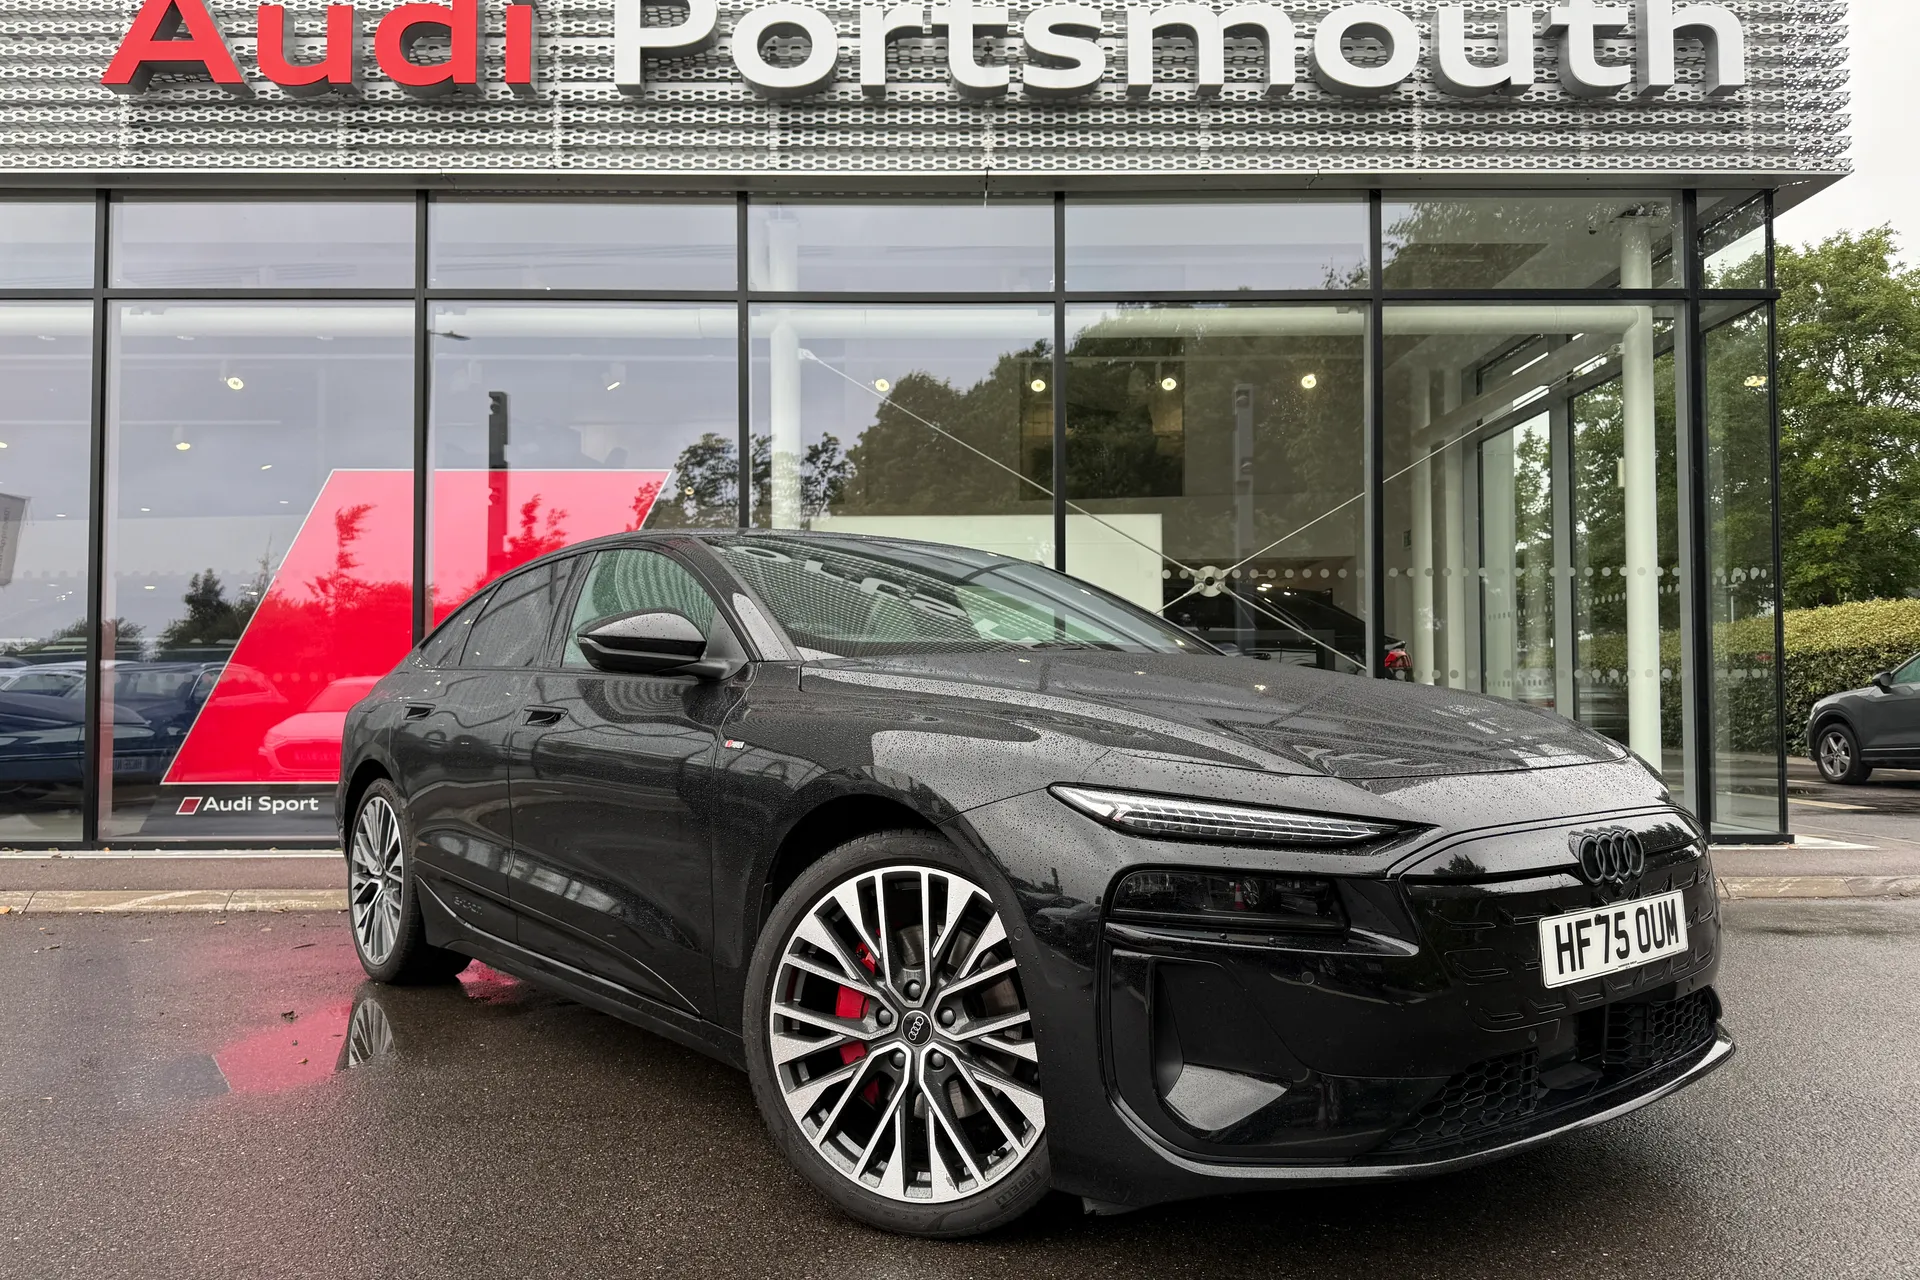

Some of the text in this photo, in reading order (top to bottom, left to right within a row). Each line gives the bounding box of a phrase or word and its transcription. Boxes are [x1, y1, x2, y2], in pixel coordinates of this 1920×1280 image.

[101, 0, 1746, 92] Audi Portsmouth
[203, 796, 319, 814] Audi Sport
[1554, 899, 1680, 975] HF75 OUM
